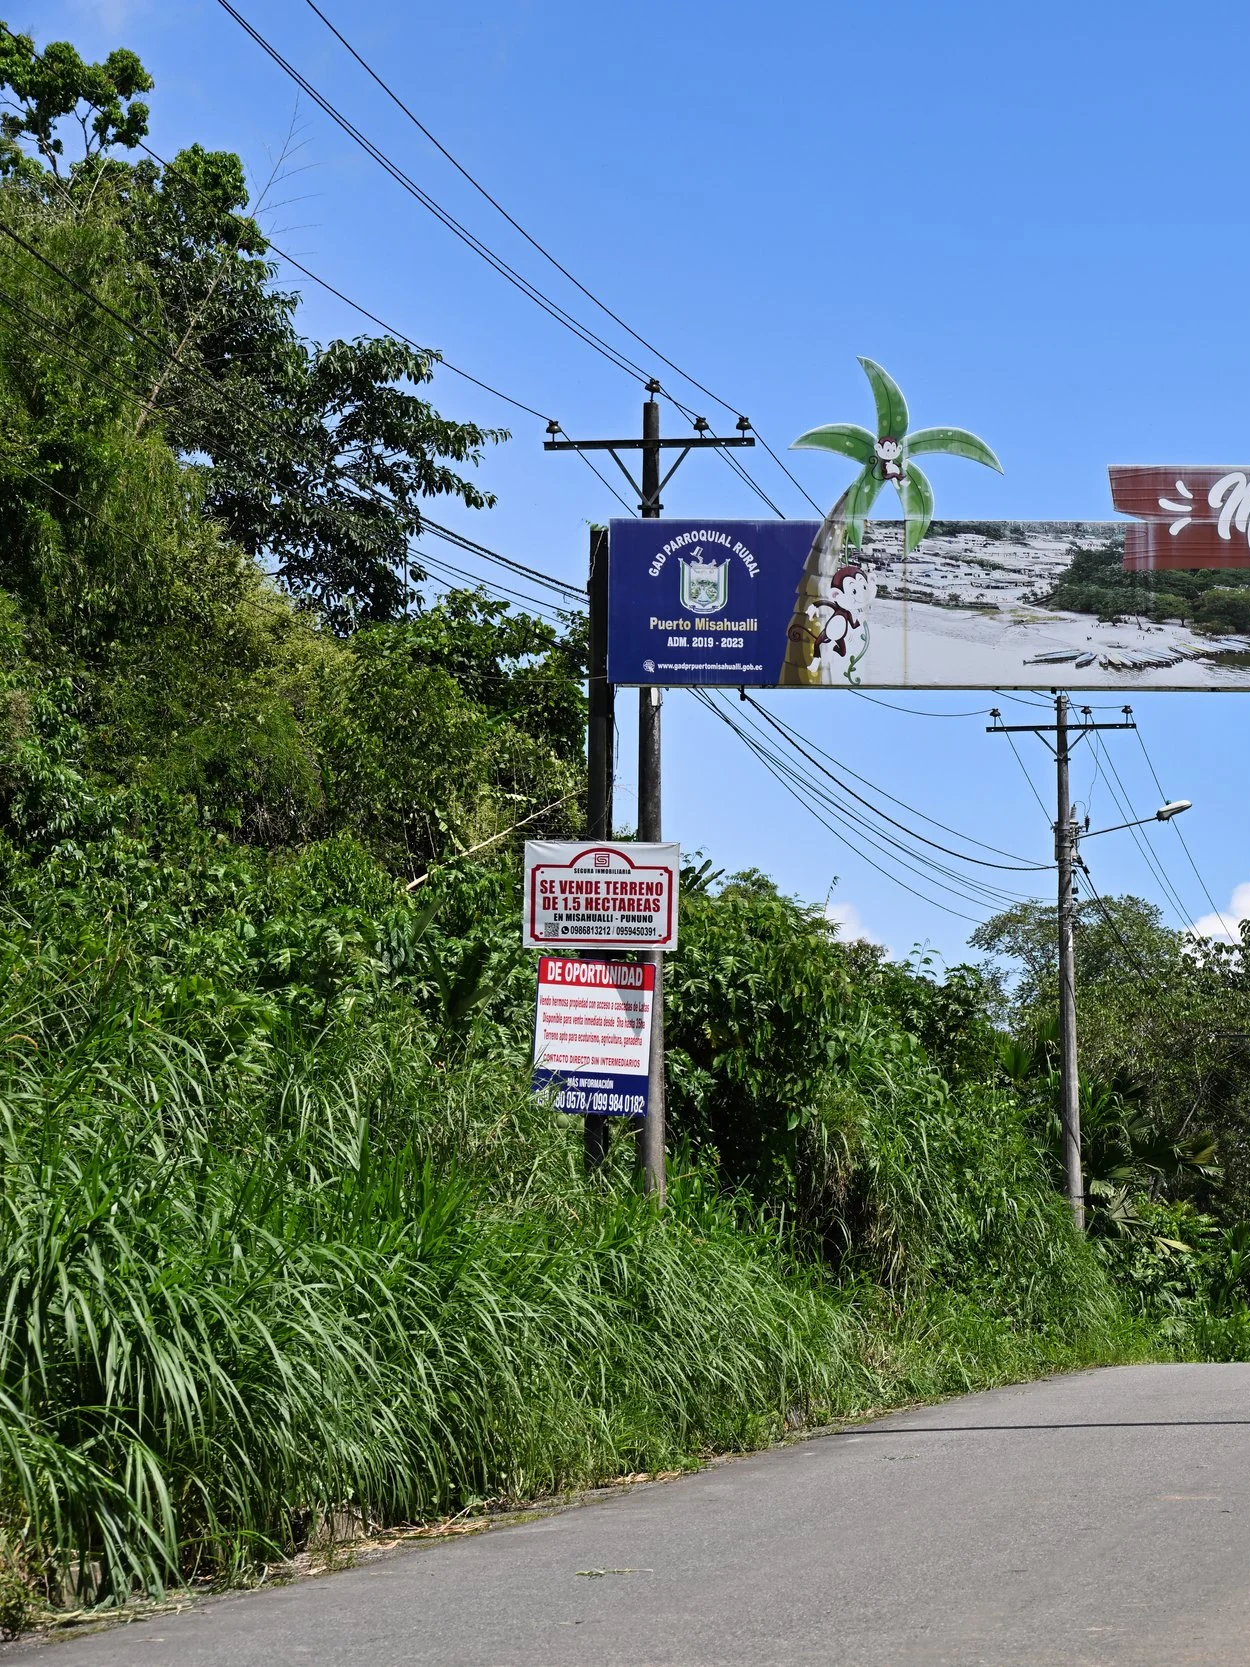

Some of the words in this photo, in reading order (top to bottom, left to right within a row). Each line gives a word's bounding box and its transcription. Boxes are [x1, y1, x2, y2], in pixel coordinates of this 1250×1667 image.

[648, 552, 666, 577] GAD
[662, 530, 731, 555] PARROQUIAL
[732, 542, 761, 578] RURAL
[650, 617, 691, 630] Puerto
[695, 618, 757, 631] Misahualli
[667, 637, 689, 648] ADM.
[692, 637, 714, 648] 2019
[721, 638, 744, 648] 2023
[658, 662, 763, 671] www.gadprpuertomisahualli.gob.ec
[540, 880, 555, 894] SE
[559, 880, 600, 895] VENDE
[604, 881, 663, 896] TERRENO
[542, 897, 558, 911] DE
[562, 897, 580, 911] 1.5
[585, 898, 660, 912] HECTAREAS
[554, 913, 563, 921] EN
[566, 913, 613, 922] MISAHUALLI
[621, 914, 653, 923] PUNUNO
[570, 926, 611, 935] 0986813212
[616, 927, 656, 936] 0959450391
[548, 962, 562, 981] DE
[565, 962, 643, 986] OPORTUNIDAD
[544, 1054, 568, 1063] CONTACTO
[570, 1055, 590, 1064] DIRECTO
[600, 1057, 640, 1068] INTERMEDIARIOS
[567, 1076, 578, 1087] MÁS
[579, 1078, 614, 1089] INFORMACIÓN
[566, 1091, 586, 1109] 0578
[593, 1092, 607, 1110] 099
[609, 1094, 623, 1111] 984
[625, 1095, 644, 1113] 0182
